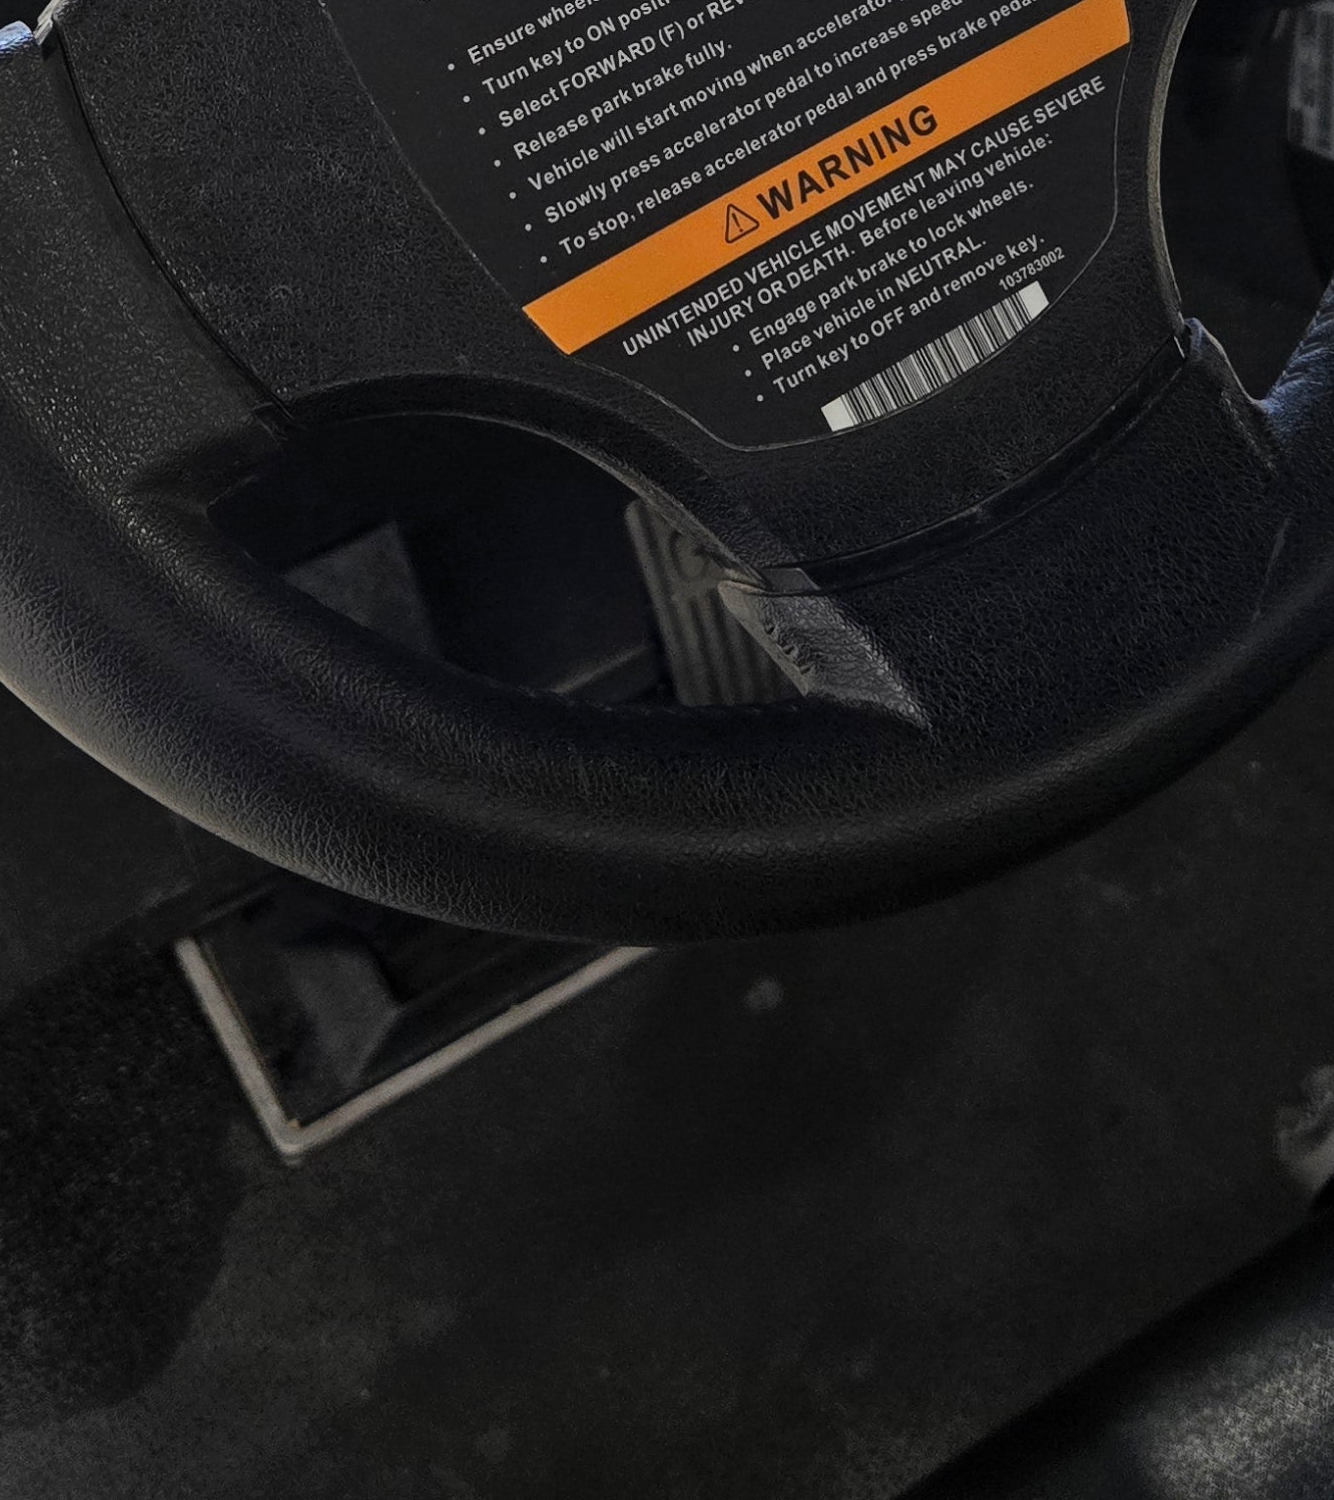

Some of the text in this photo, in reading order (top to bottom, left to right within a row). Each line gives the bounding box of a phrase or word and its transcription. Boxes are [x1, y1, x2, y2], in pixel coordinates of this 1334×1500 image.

[467, 23, 536, 64] Ensure
[482, 66, 529, 94] Turn
[529, 47, 563, 72] key
[564, 37, 585, 54] to
[587, 17, 616, 41] ON
[499, 87, 560, 127] Select
[558, 36, 656, 96] FORWARD
[658, 21, 684, 48] (F)
[687, 12, 704, 30] or
[513, 40, 732, 160] Release park brake fully.
[527, 148, 599, 190] Vehicle
[600, 125, 634, 153] will
[635, 102, 679, 135] start
[679, 69, 747, 112] moving
[746, 44, 795, 75] when
[545, 182, 606, 223] Slowly
[610, 154, 661, 193] press
[663, 98, 761, 160] accelerator
[764, 68, 813, 109] pedal
[814, 62, 833, 78] to
[833, 22, 908, 67] increase
[559, 236, 585, 254] To
[588, 211, 636, 240] stop,
[636, 171, 702, 214] release
[704, 115, 801, 177] accelerator
[805, 85, 853, 125] pedal
[855, 66, 888, 94] and
[889, 44, 938, 80] press
[937, 17, 988, 49] brake
[756, 105, 937, 219] WARNING
[623, 76, 1105, 355] UNINTENDED VEHICLE MOVEMENT MAY CAUSE SEVERE
[687, 133, 1052, 347] INJURY OR DEATH. Before leaving vehicle:
[749, 181, 1033, 345] Engage park brake to lock wheels.
[999, 247, 1065, 290] 103783002
[761, 236, 986, 370] Place vehicle in NEUTRAL.
[773, 234, 1044, 393] Turn key to OFF and remove key.
